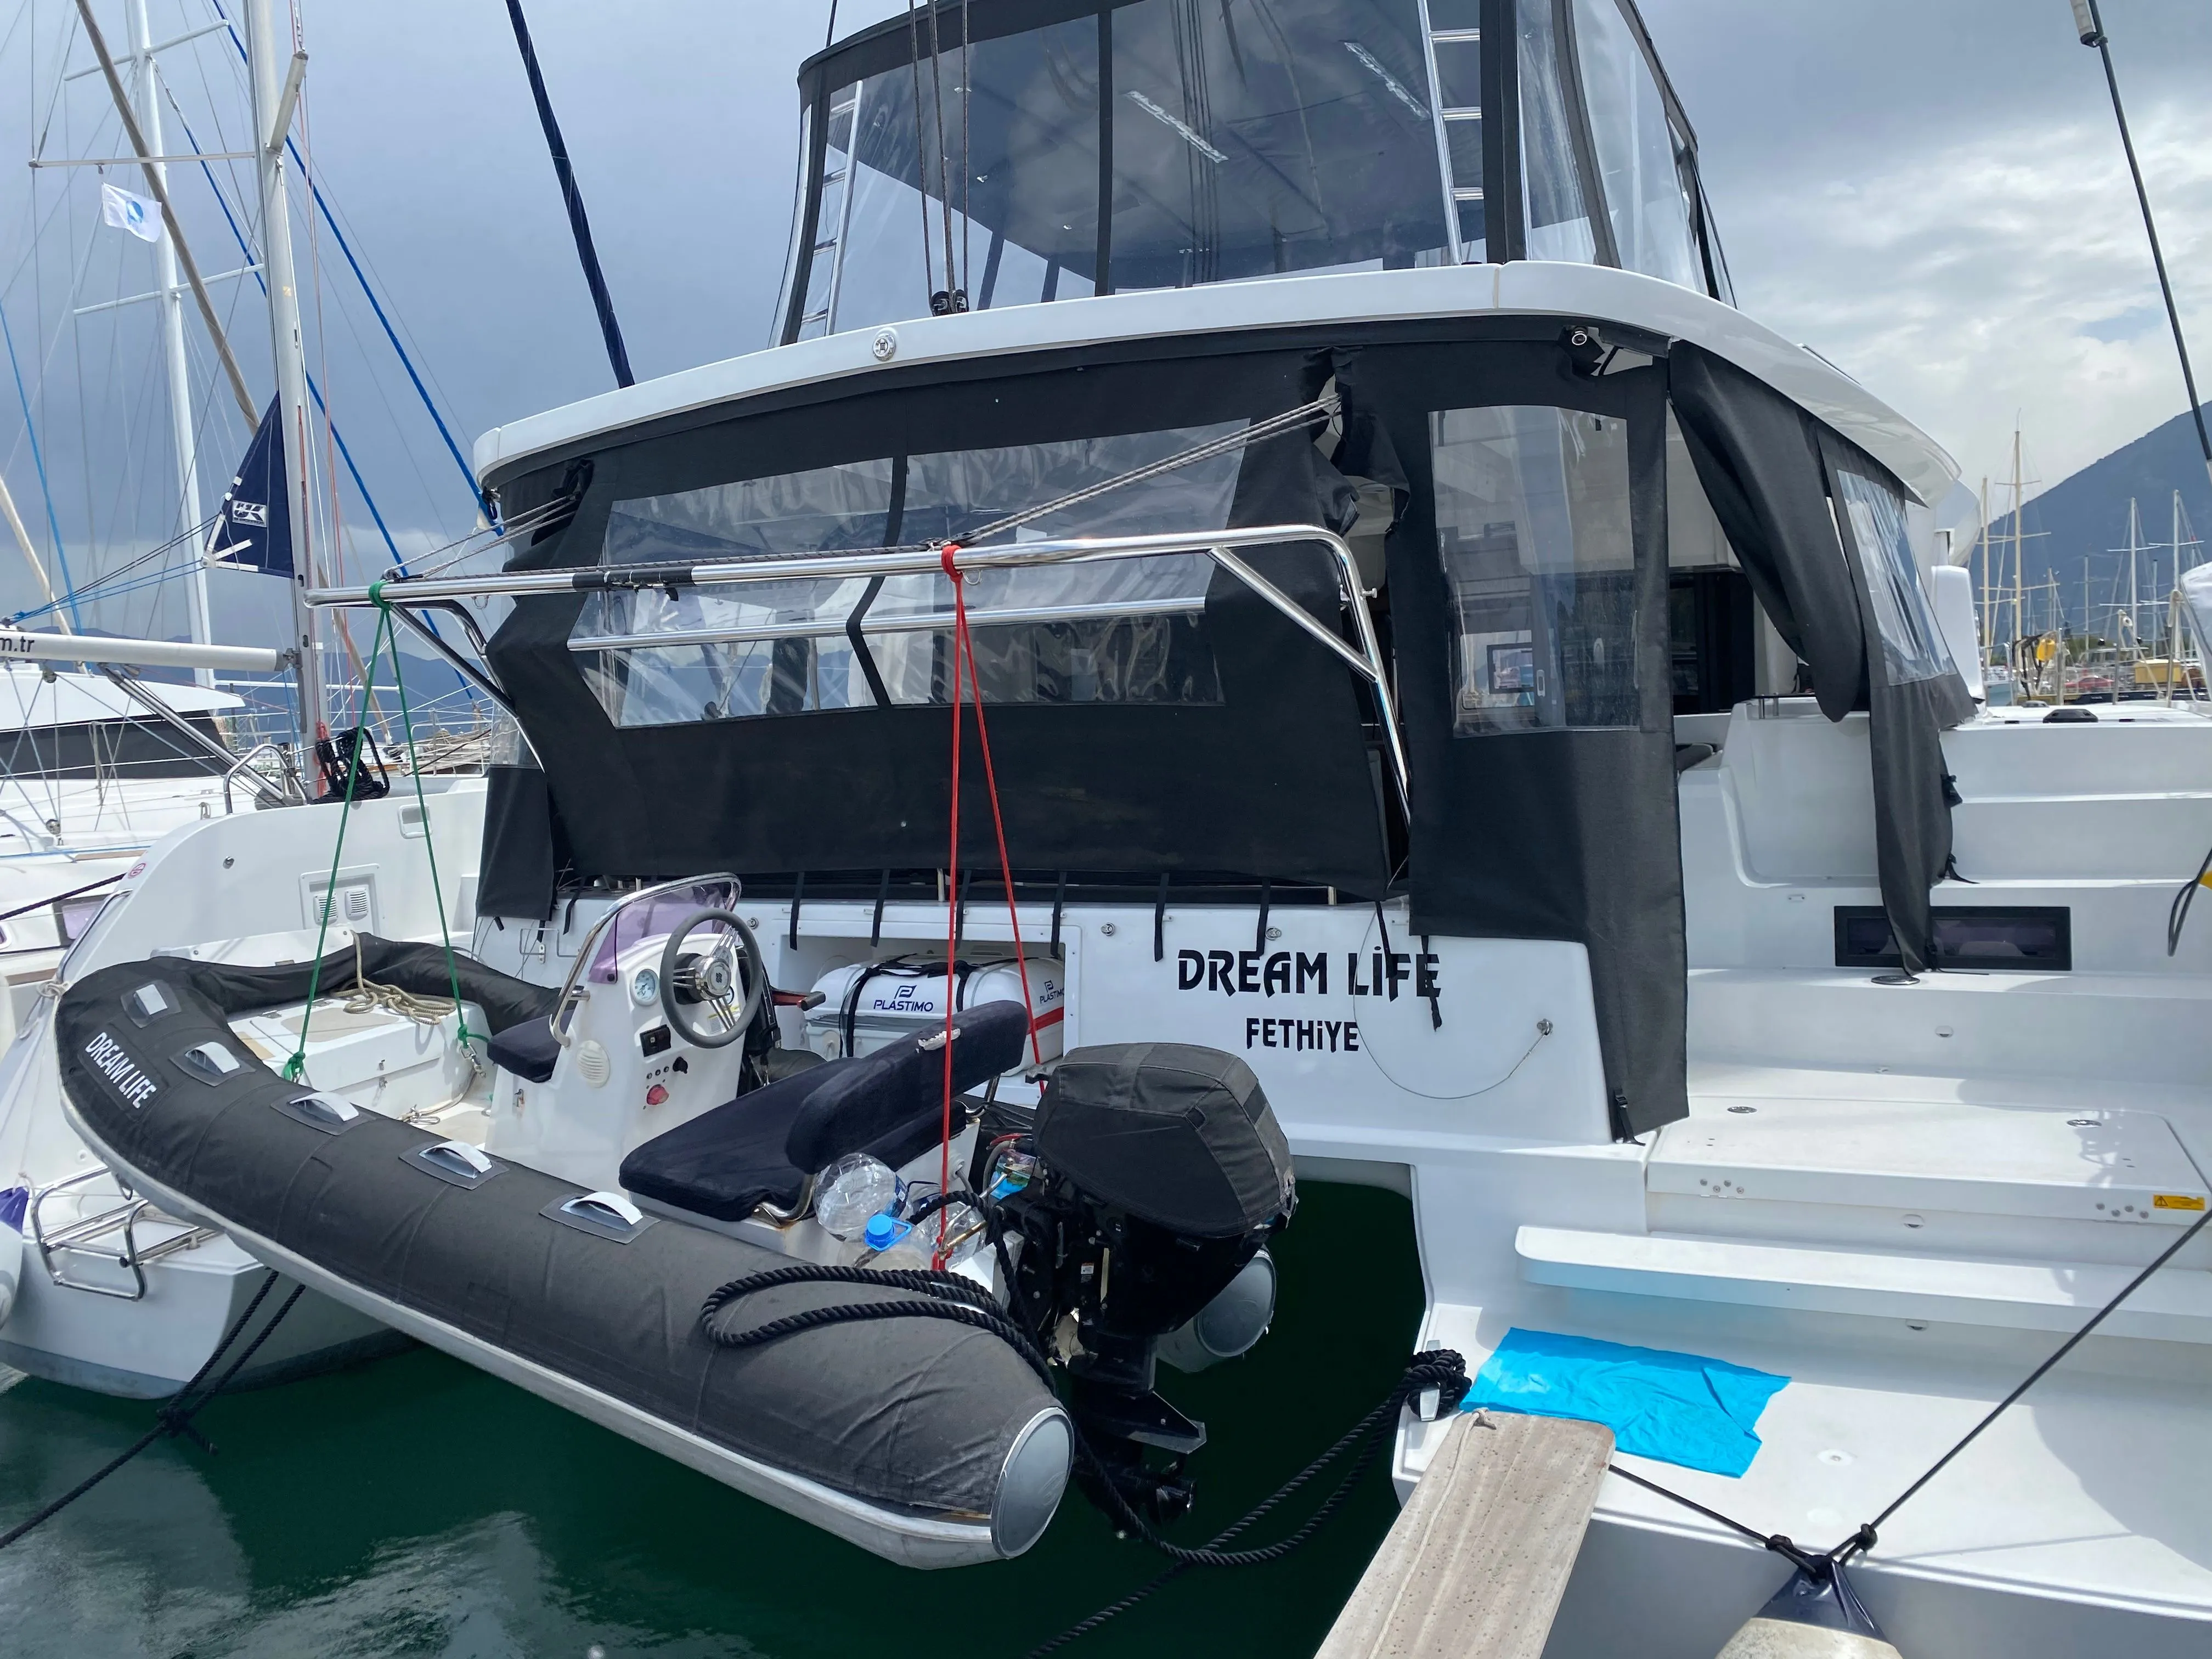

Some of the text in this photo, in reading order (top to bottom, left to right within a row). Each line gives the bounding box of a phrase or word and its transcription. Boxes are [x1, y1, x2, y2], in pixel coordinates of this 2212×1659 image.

[1178, 949, 1328, 998] DREAM
[873, 1000, 934, 1012] PLASTIMO
[85, 1032, 157, 1109] DREAM LIFE
